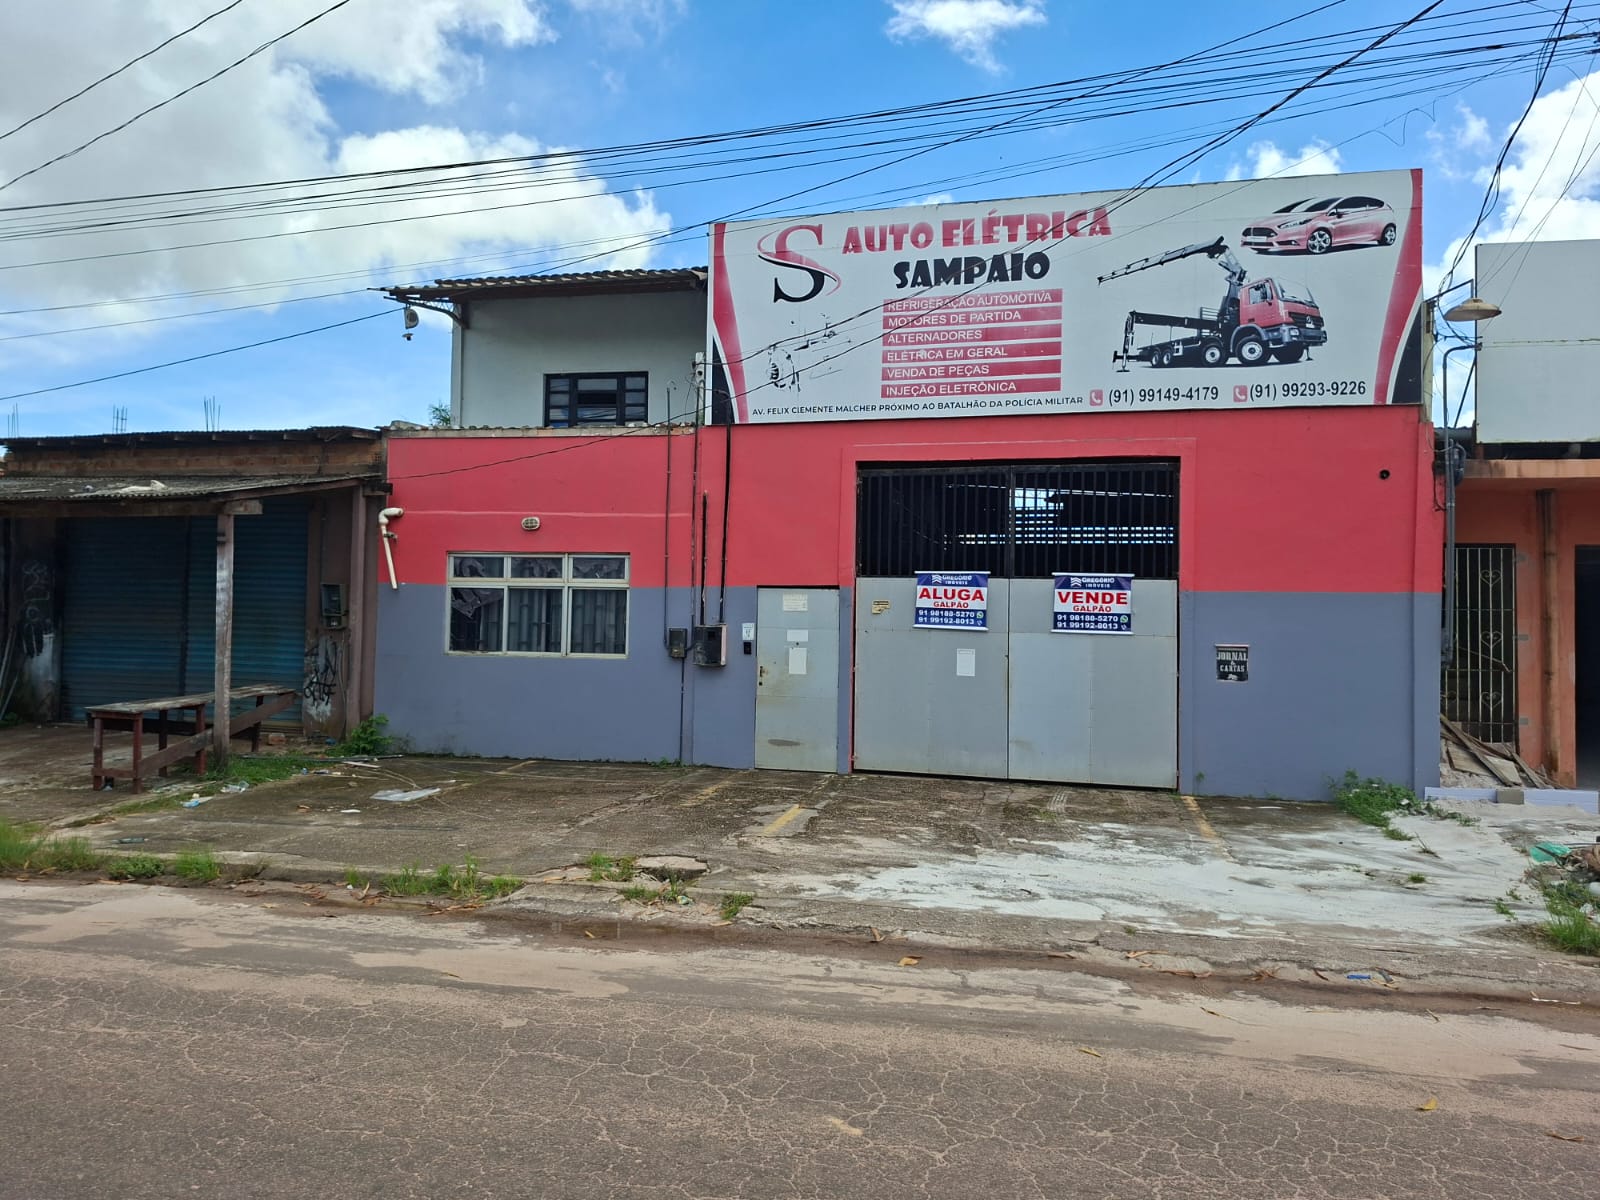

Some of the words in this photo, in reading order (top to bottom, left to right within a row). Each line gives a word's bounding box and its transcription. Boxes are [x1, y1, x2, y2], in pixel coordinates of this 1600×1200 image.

[842, 222, 934, 254] AUTO
[942, 207, 1112, 248] ELÉTRICA
[894, 251, 1050, 289] SAMPAIO
[888, 295, 975, 312] REFRIGERAÇÃO
[977, 292, 1052, 305] AUTOMOTIVA
[888, 314, 947, 327] MOTORES
[950, 313, 966, 324] DE
[970, 311, 1021, 322] PARTIDA
[887, 330, 982, 343] ALTERNADORES
[887, 349, 943, 361] ELÉTRICA
[946, 348, 964, 359] EM
[967, 347, 1008, 357] GERAL
[887, 367, 926, 378] VENDA
[929, 366, 945, 376] DE
[948, 364, 989, 377] PEÇAS
[886, 383, 937, 397] INJEÇÃO
[939, 381, 1016, 393] ELETRÔNICA
[1108, 388, 1134, 406] (91)
[1138, 387, 1219, 402] 99149-4179
[1249, 383, 1277, 401] (91)
[1281, 381, 1366, 397] 99293-9226
[767, 407, 790, 415] FELIX
[791, 405, 833, 414] CLEMENTE
[835, 404, 877, 413] MALCHER
[878, 402, 920, 412] PRÓXIMO
[922, 402, 936, 410] AO
[937, 400, 987, 410] BATALHÃO
[989, 400, 1003, 408] DA
[1005, 397, 1043, 407] POLÍCIA
[1045, 396, 1083, 406] MILITAR
[919, 587, 984, 601] ALUGA
[1057, 591, 1128, 605] VENDE
[1073, 604, 1112, 613] GALPÃO
[1216, 652, 1247, 661] JORNAL
[1220, 664, 1245, 673] CARTAS
